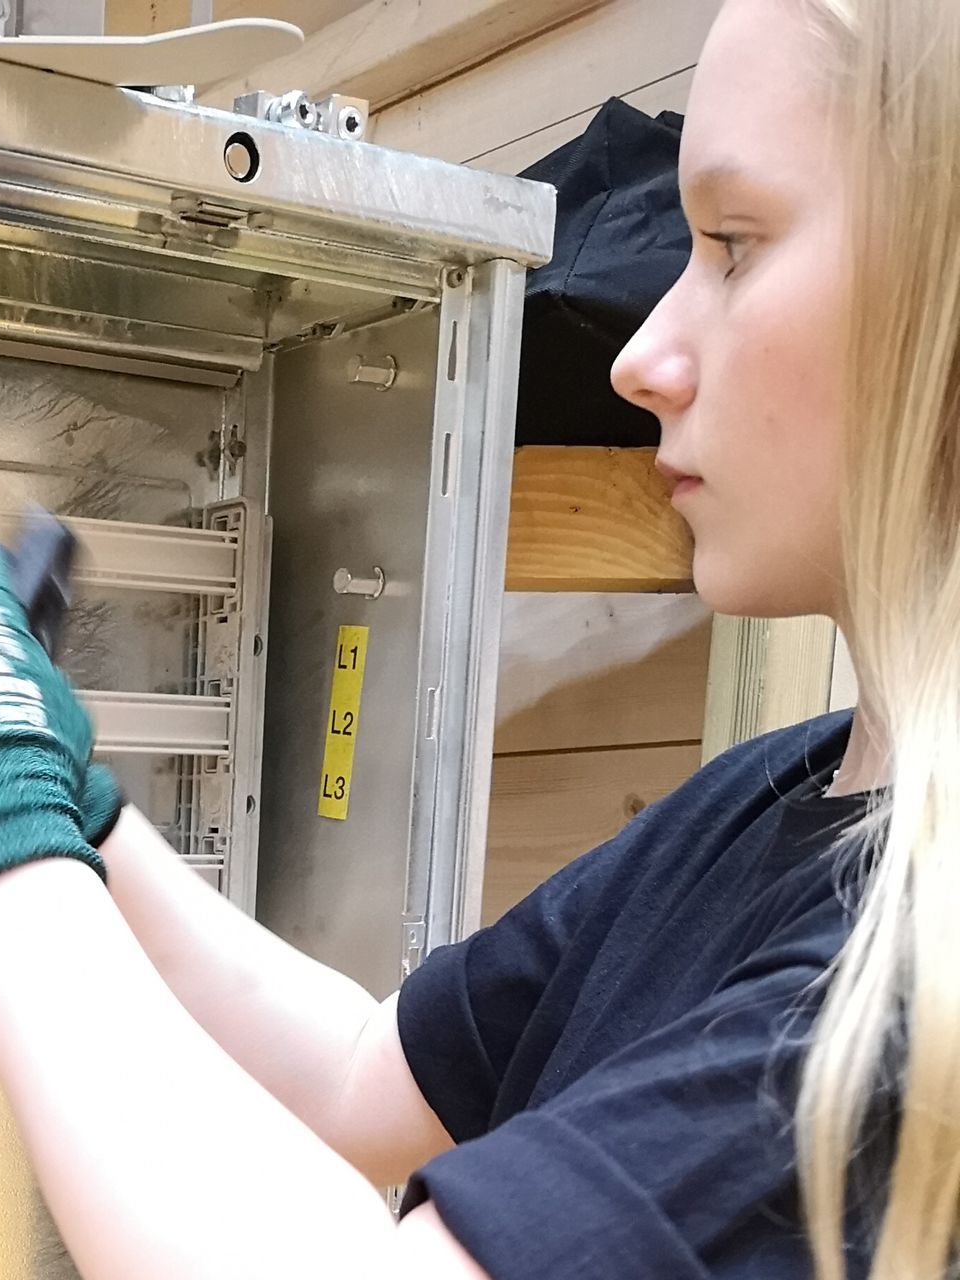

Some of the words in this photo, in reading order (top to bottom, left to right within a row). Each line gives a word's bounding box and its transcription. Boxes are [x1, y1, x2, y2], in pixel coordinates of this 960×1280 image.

[337, 644, 358, 670] L1
[330, 709, 354, 736] L2
[322, 773, 346, 800] L3
